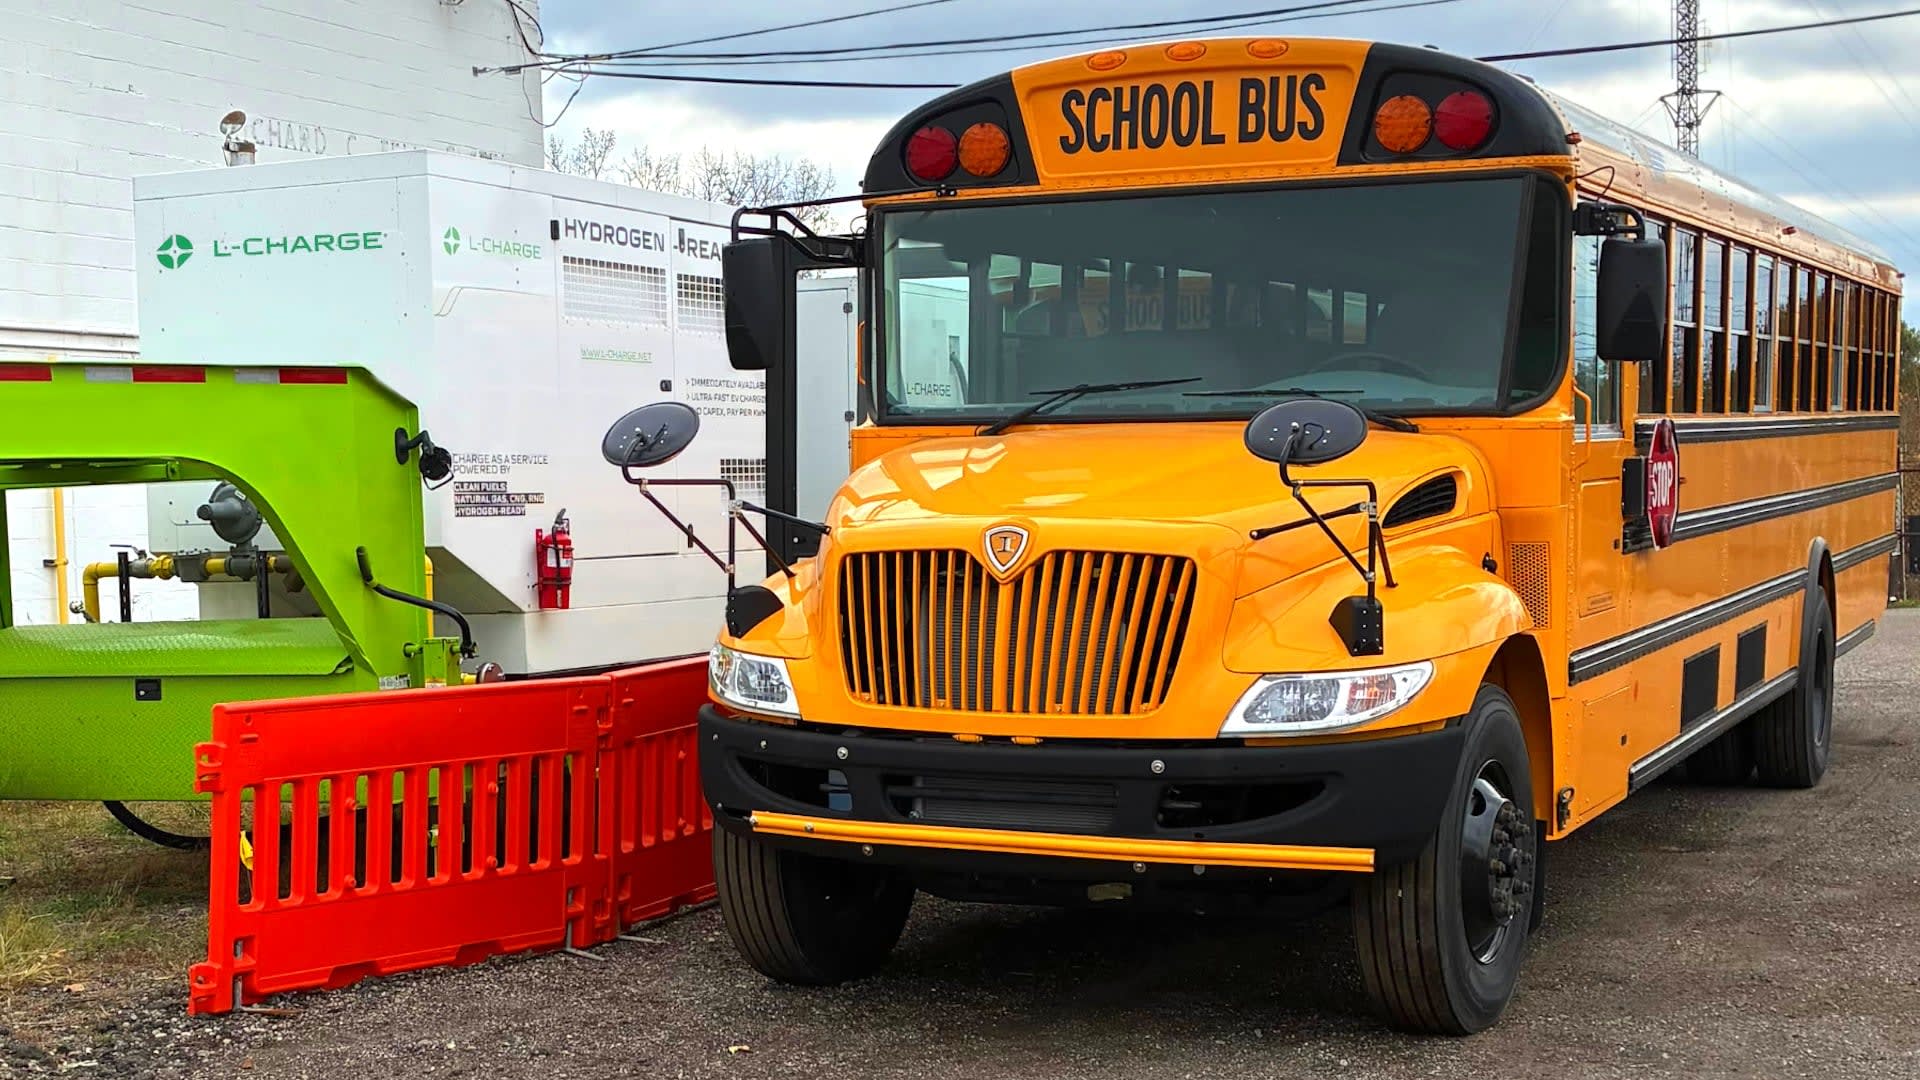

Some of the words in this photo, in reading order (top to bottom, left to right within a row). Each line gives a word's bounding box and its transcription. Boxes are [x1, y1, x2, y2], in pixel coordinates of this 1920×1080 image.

[1059, 80, 1227, 155] SCHOOL
[1238, 72, 1326, 144] BUS
[564, 217, 665, 252] HYDROGEN
[213, 231, 383, 257] L-CHARGE
[469, 234, 542, 260] L-CHARGE
[738, 381, 766, 389] AVAILAB
[906, 382, 951, 397] L-CHARGE
[691, 393, 712, 401] ULTRA
[714, 393, 729, 402] FAST
[453, 454, 490, 464] CHARGE
[491, 454, 503, 464] AS
[504, 455, 510, 464] A
[511, 455, 548, 465] SERVICE
[453, 465, 498, 474] POWERED
[500, 465, 511, 474] BY
[454, 482, 480, 492] CLEAN
[481, 482, 506, 492] FUELS
[1652, 460, 1673, 508] STOP
[454, 494, 490, 504] NATURAL
[455, 506, 525, 516] HYDROGEN-READY
